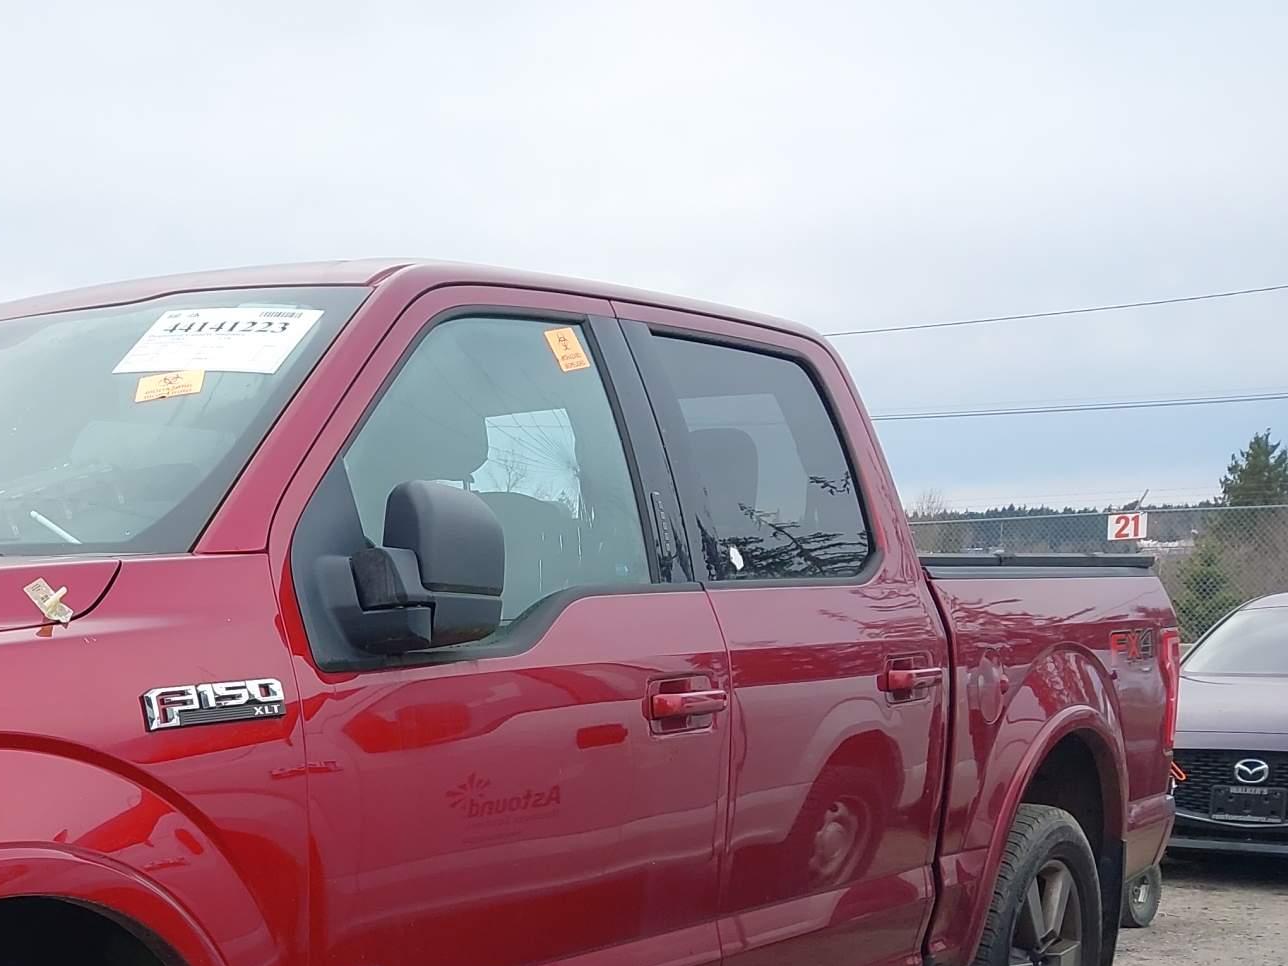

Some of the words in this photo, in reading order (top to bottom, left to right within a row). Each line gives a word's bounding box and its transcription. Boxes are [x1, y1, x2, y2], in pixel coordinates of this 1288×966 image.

[163, 321, 290, 333] 44141223
[1115, 515, 1139, 538] 21
[1109, 627, 1154, 660] FX4
[143, 677, 285, 731] F150
[253, 704, 281, 716] XLT
